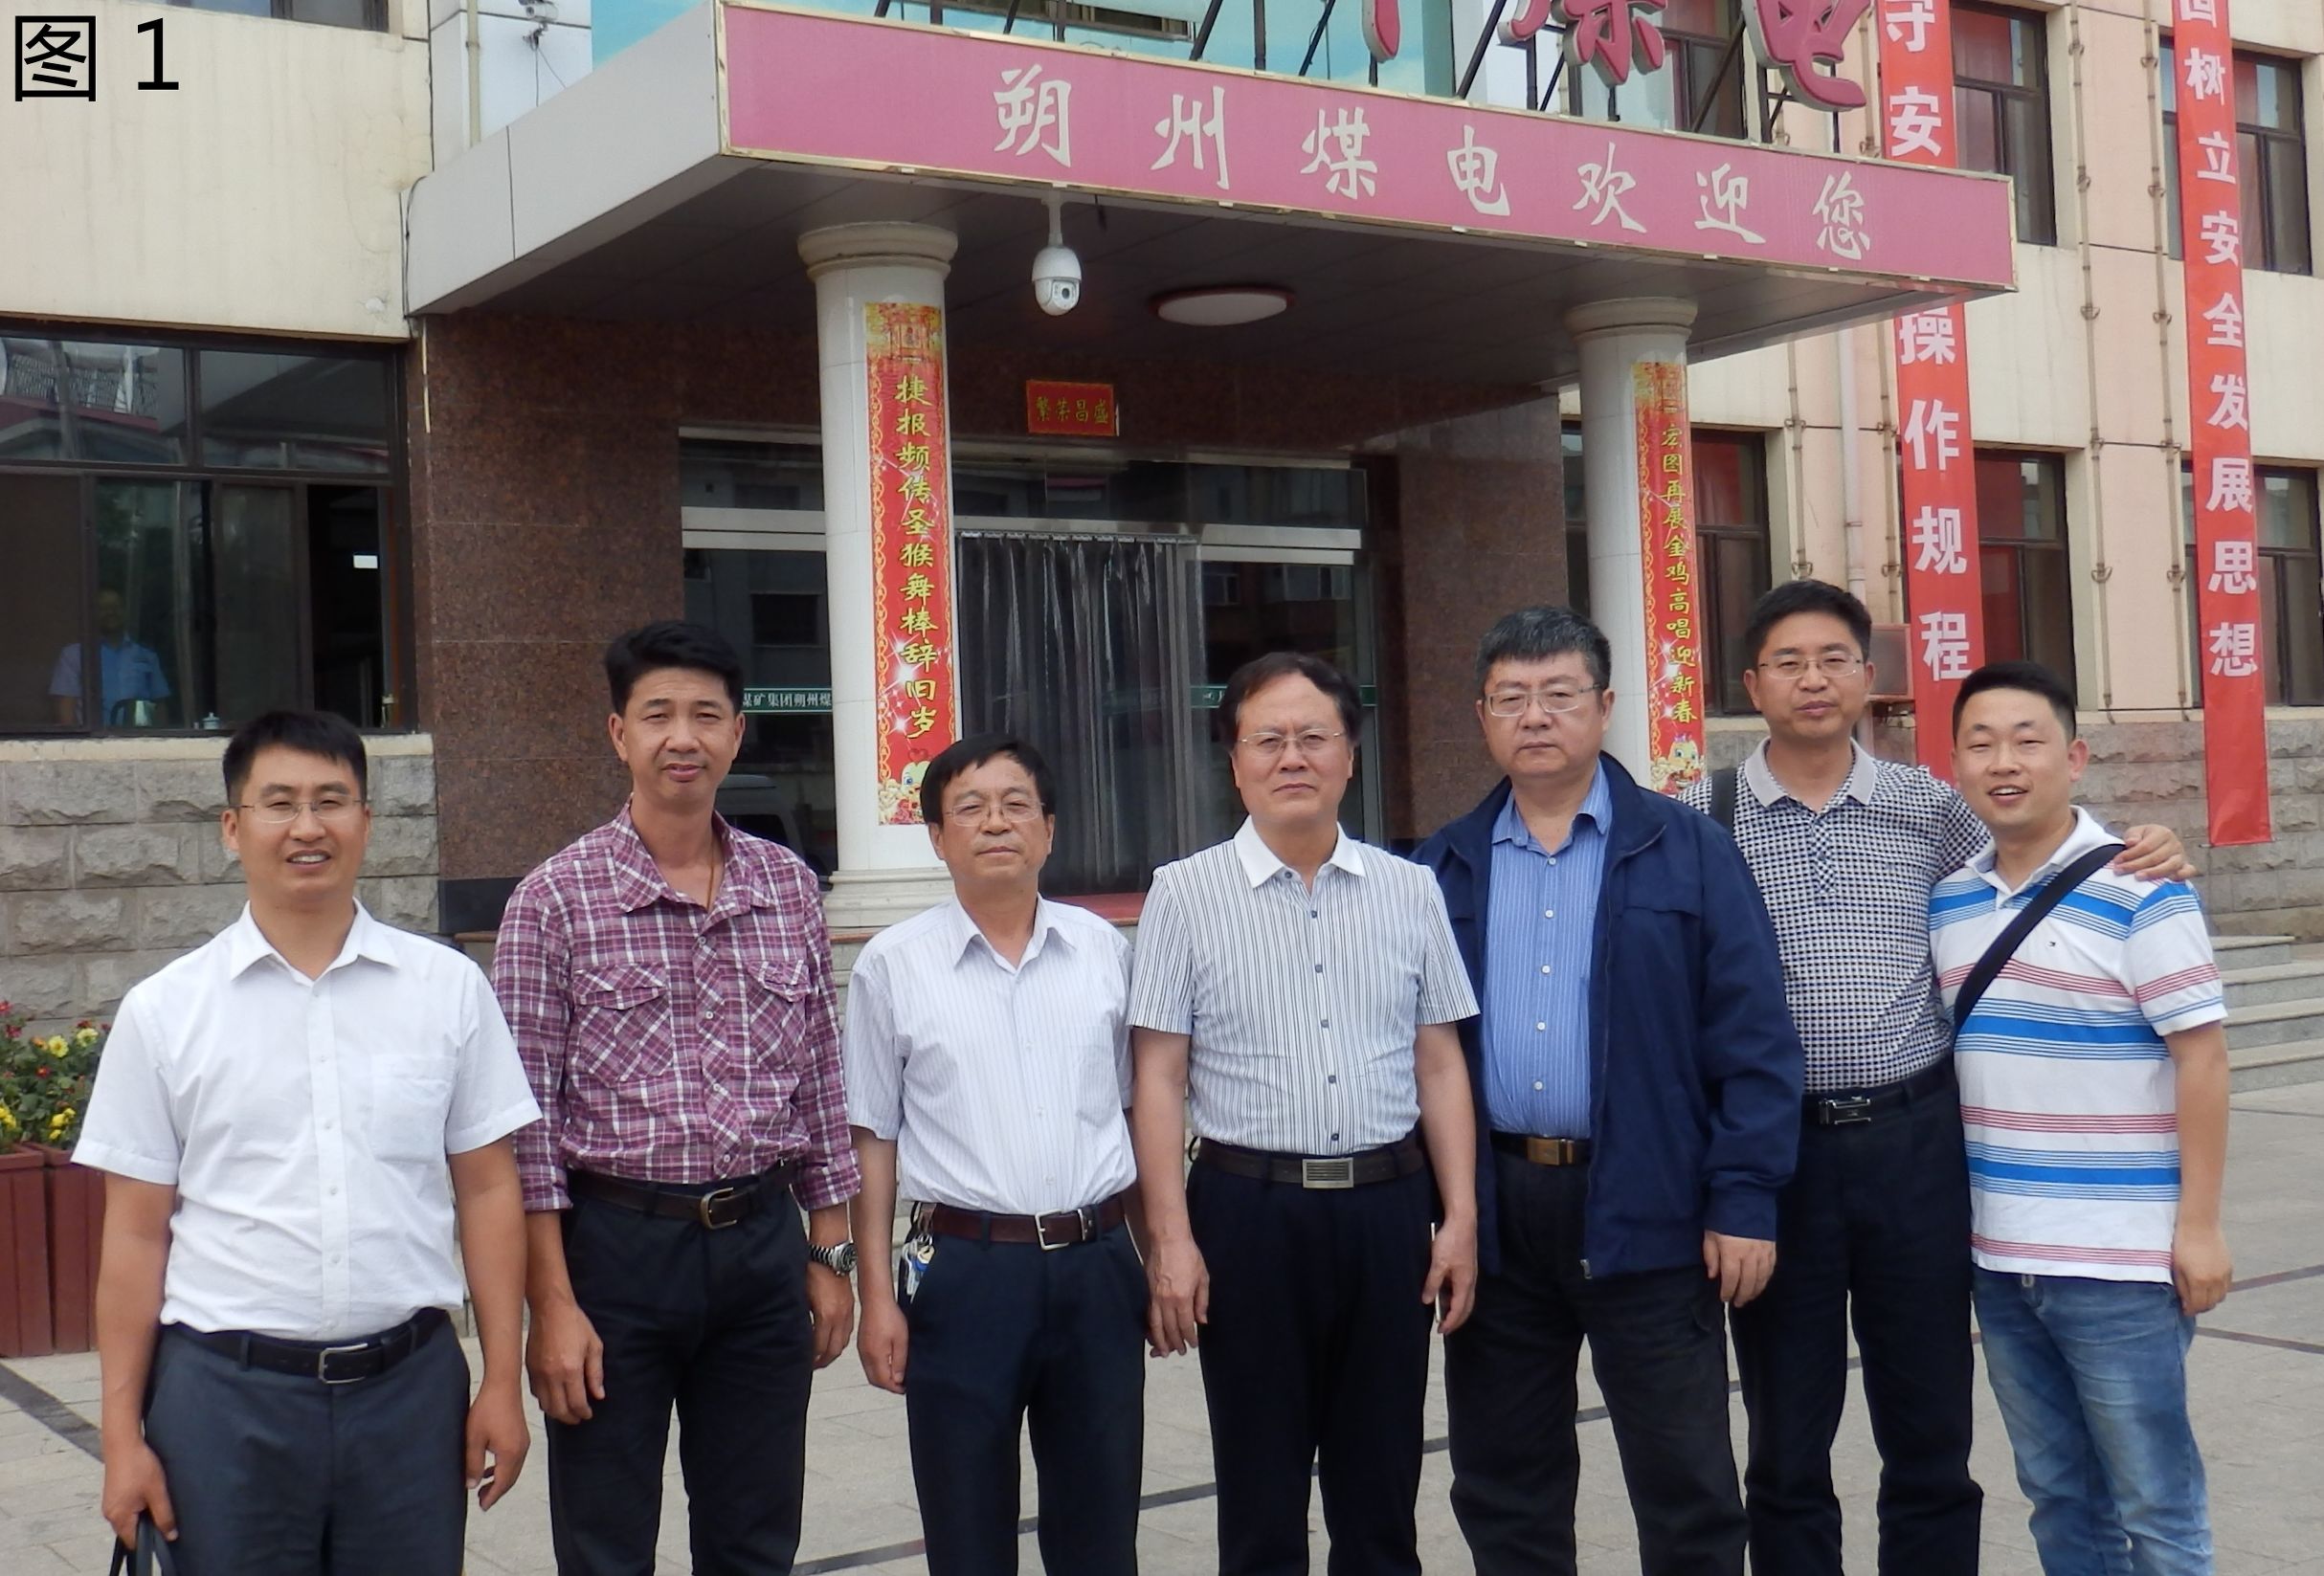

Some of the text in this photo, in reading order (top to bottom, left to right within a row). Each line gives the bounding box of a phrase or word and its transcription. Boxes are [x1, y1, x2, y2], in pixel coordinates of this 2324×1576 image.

[993, 63, 1872, 261] 朔州煤电欢迎您
[1036, 396, 1109, 425] 繁荣昌盛
[893, 374, 939, 740] 捷报频传圣猴舞棒辞旧岁
[1661, 422, 1699, 724] 宏图再展金鸡高唱迎新春
